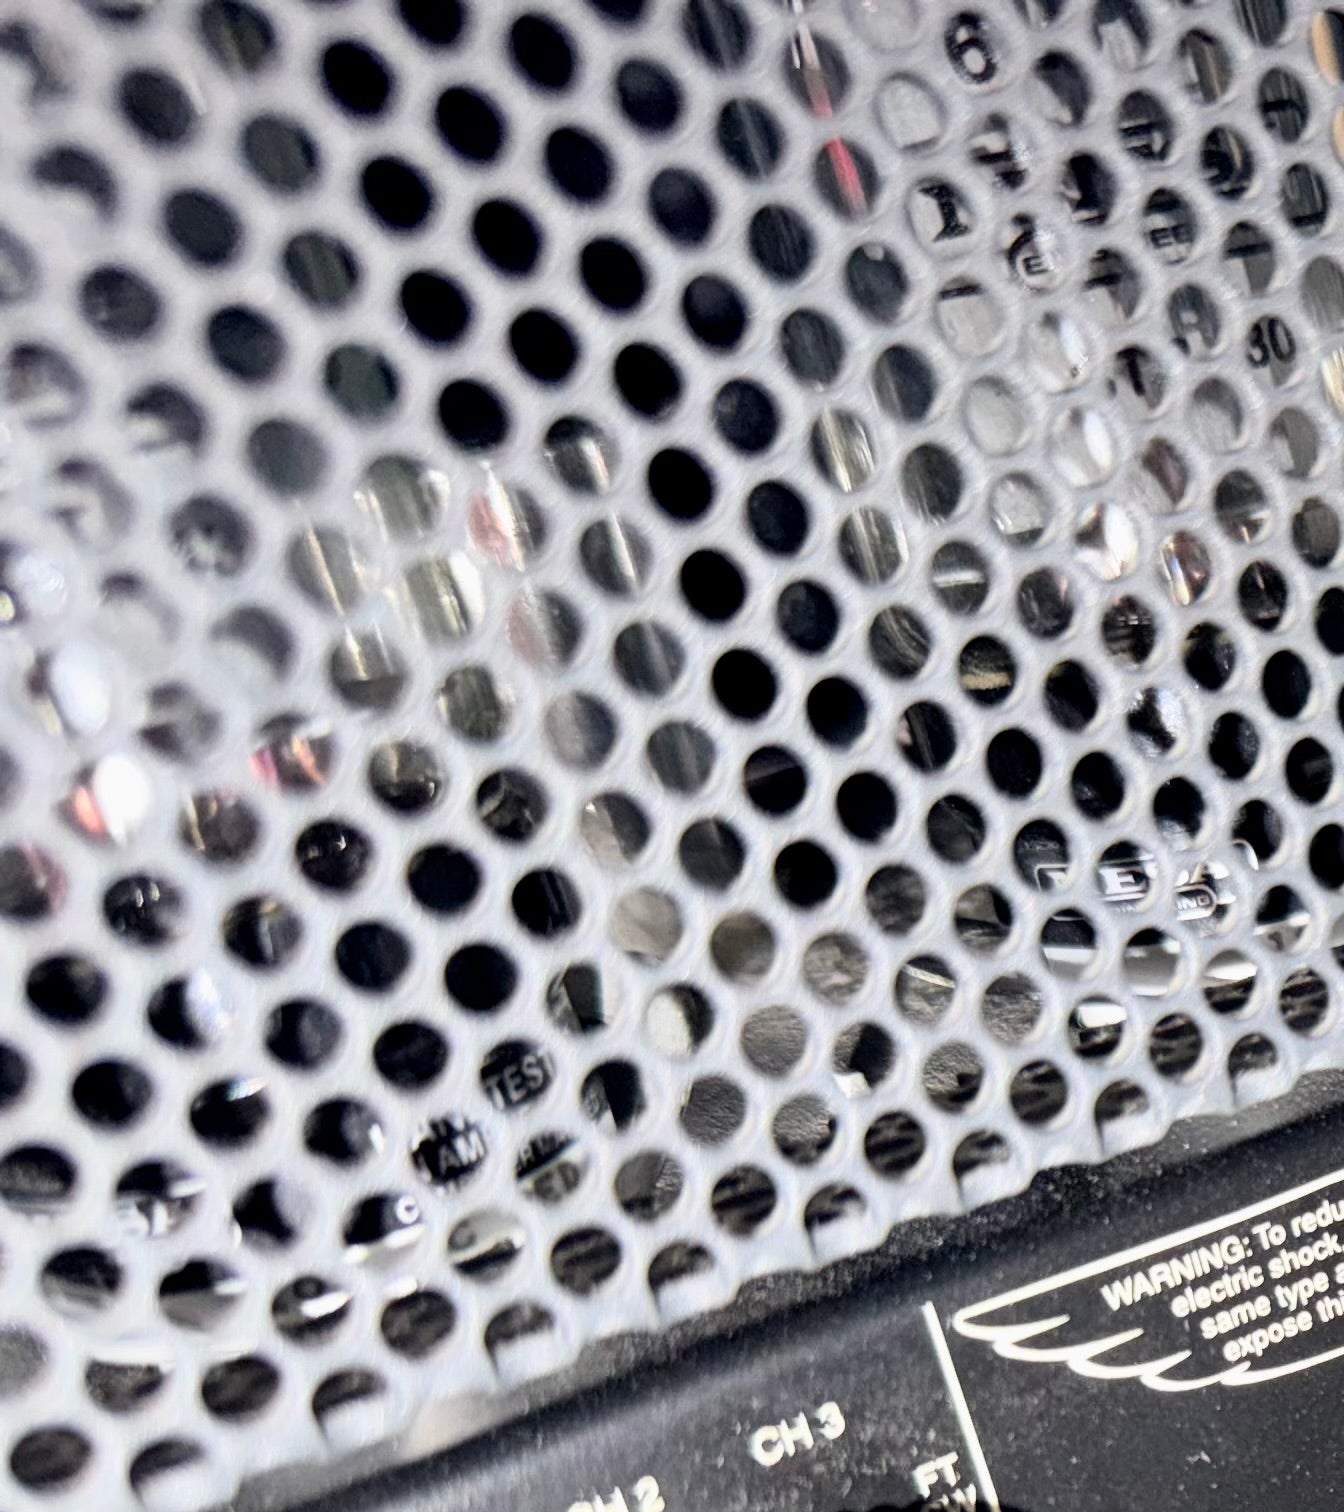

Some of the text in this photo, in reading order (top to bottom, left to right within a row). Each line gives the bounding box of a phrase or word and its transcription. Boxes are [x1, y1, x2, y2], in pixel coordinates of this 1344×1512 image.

[1101, 1235, 1254, 1312] WARNING:
[1252, 1222, 1287, 1250] To
[1171, 1265, 1264, 1318] electric
[1200, 1295, 1271, 1340] same
[1274, 1272, 1330, 1312] type
[1223, 1311, 1313, 1362] expose
[749, 1401, 847, 1468] CH 3
[912, 1450, 959, 1499] FT
